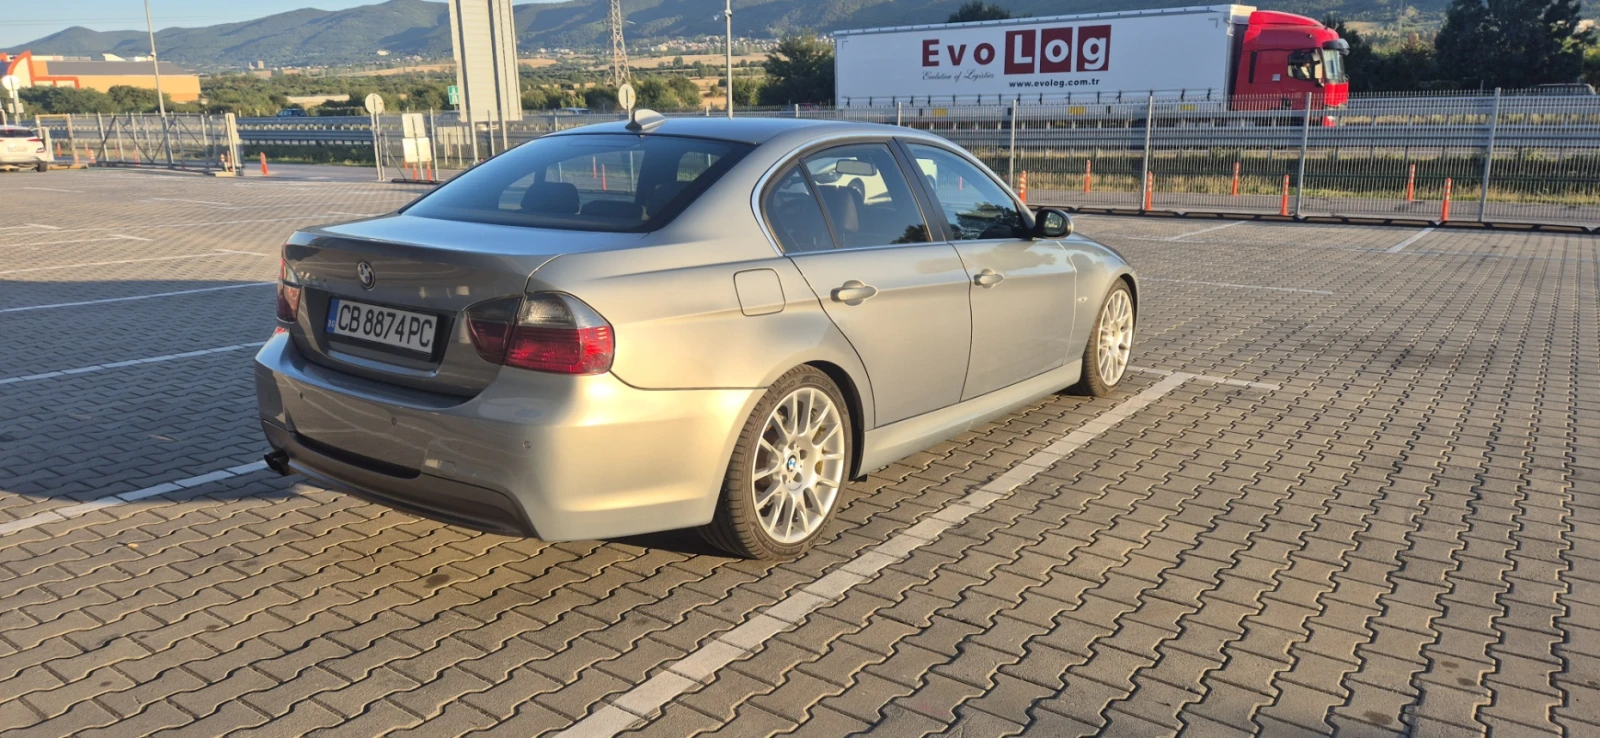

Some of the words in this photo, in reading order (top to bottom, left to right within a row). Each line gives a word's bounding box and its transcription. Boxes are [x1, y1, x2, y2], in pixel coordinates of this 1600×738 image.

[921, 71, 952, 81] Evolution
[953, 72, 961, 83] of
[963, 70, 995, 82] Logistics
[1008, 78, 1101, 89] www.evolog.com.tr
[338, 304, 362, 333] CB
[363, 309, 406, 343] 8874
[407, 317, 433, 347] PC
[770, 380, 796, 406] KUMHO
